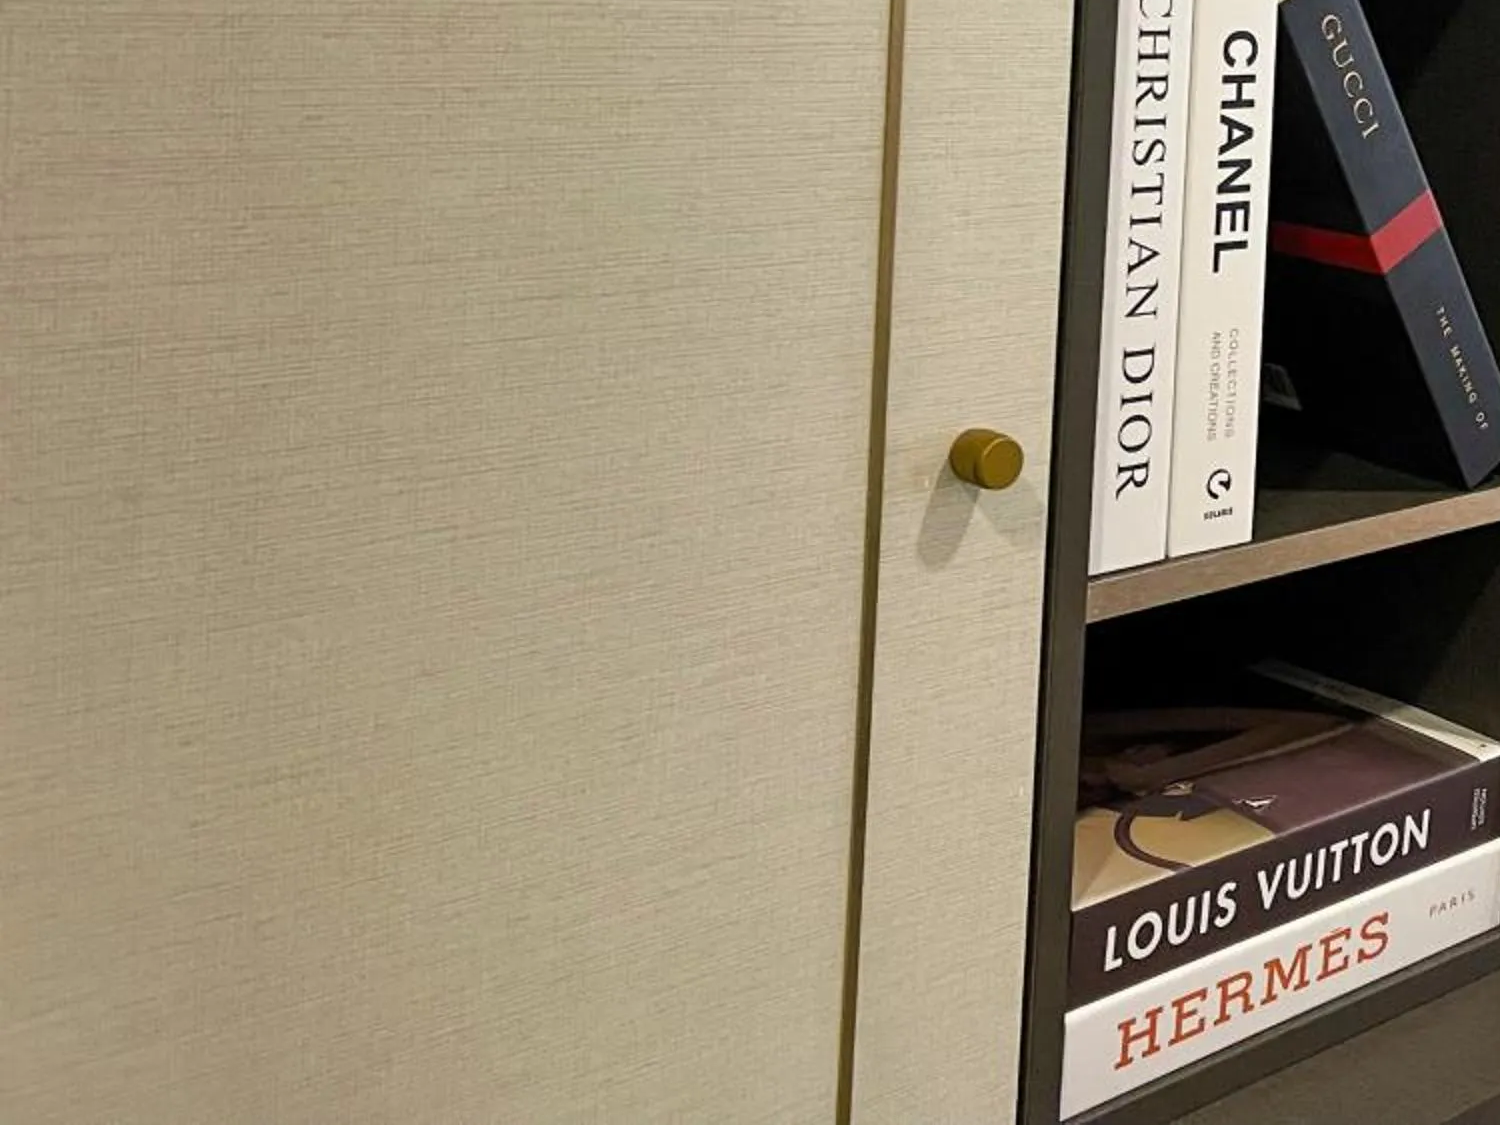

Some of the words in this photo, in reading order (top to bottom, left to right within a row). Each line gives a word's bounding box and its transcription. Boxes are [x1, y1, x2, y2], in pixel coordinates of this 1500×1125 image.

[1321, 12, 1378, 140] GUCCI
[1212, 29, 1259, 274] CHANEL
[1115, 345, 1156, 500] DIOR
[1206, 362, 1220, 441] CREATIONS
[1223, 328, 1239, 438] COLLECTIONS
[1449, 345, 1477, 404] MAKING
[1104, 881, 1237, 972] LOUIS
[1257, 809, 1430, 910] VUITTON
[1428, 889, 1476, 918] PARIS
